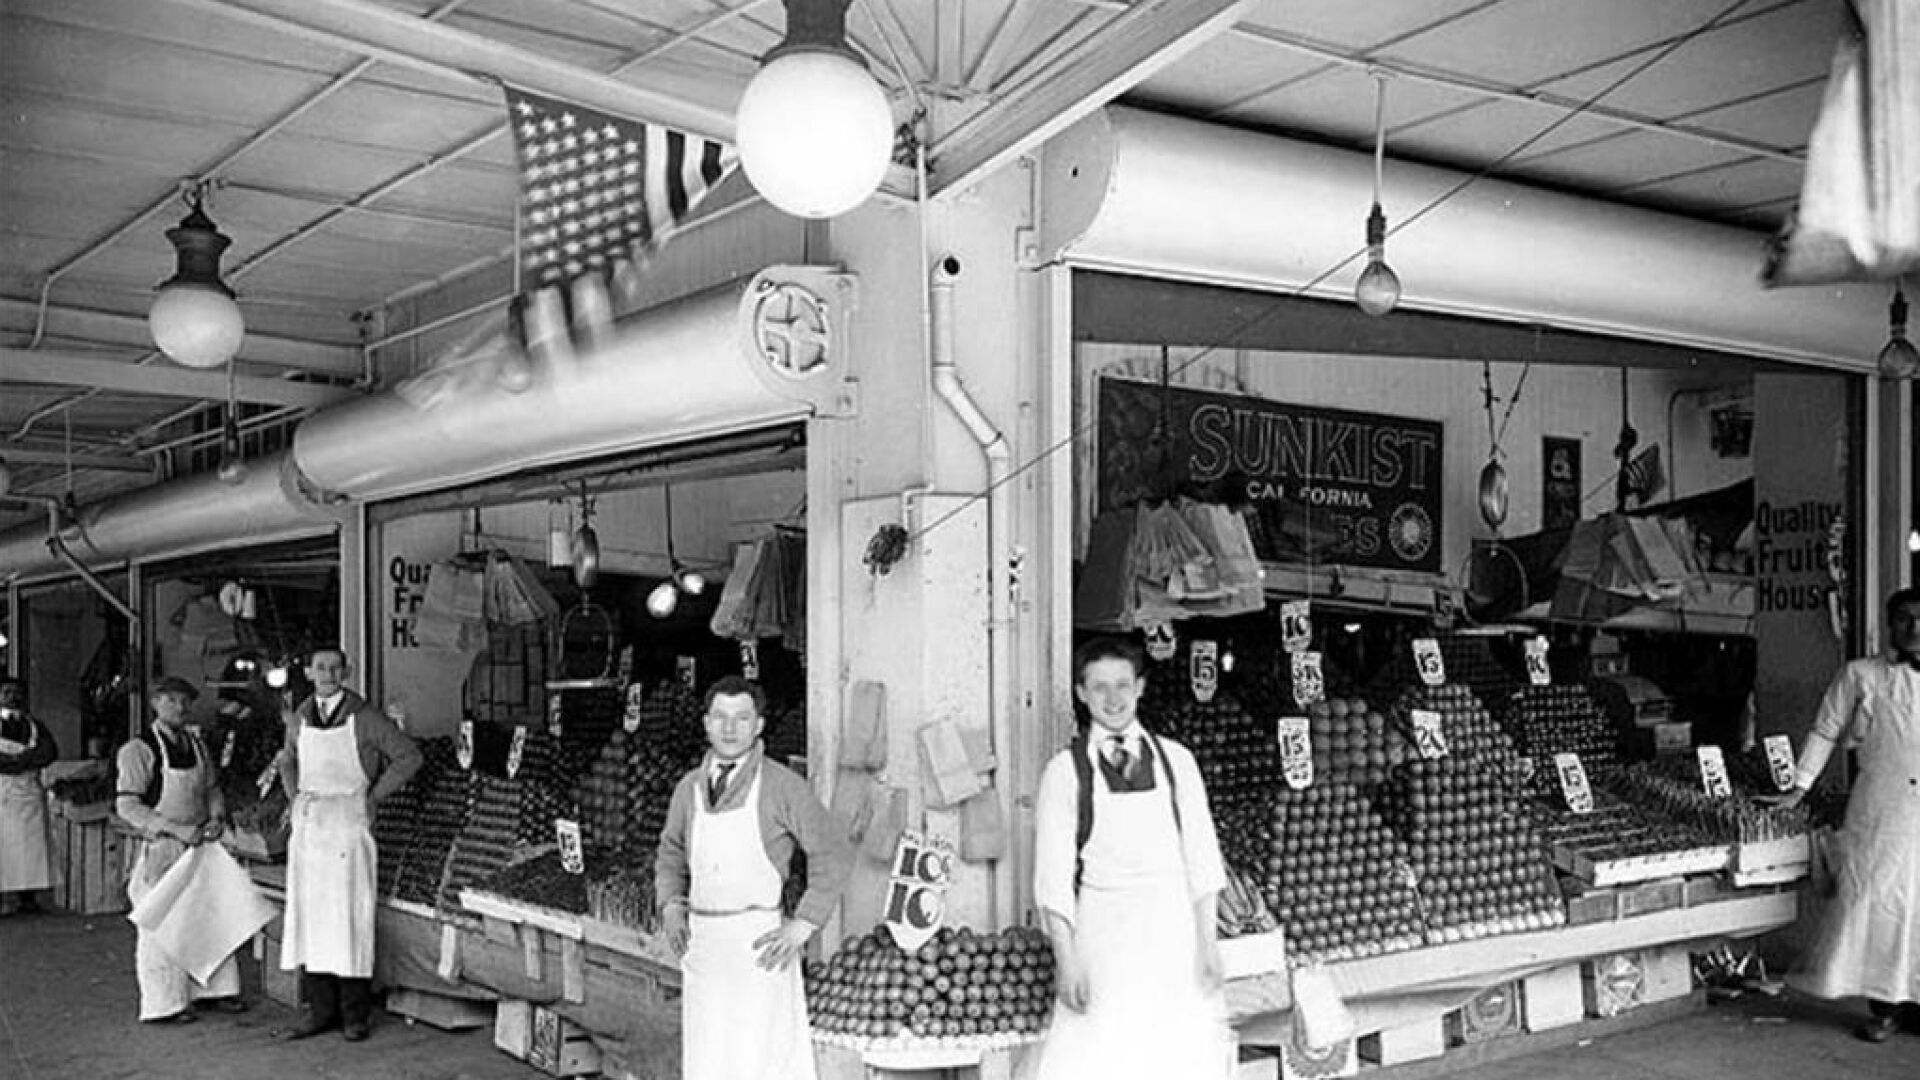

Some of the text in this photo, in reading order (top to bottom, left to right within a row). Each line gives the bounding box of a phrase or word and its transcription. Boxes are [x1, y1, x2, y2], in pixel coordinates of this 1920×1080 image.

[1188, 404, 1435, 489] SUNKIST
[1247, 480, 1373, 508] CALFORNIA
[1194, 652, 1217, 681] 15
